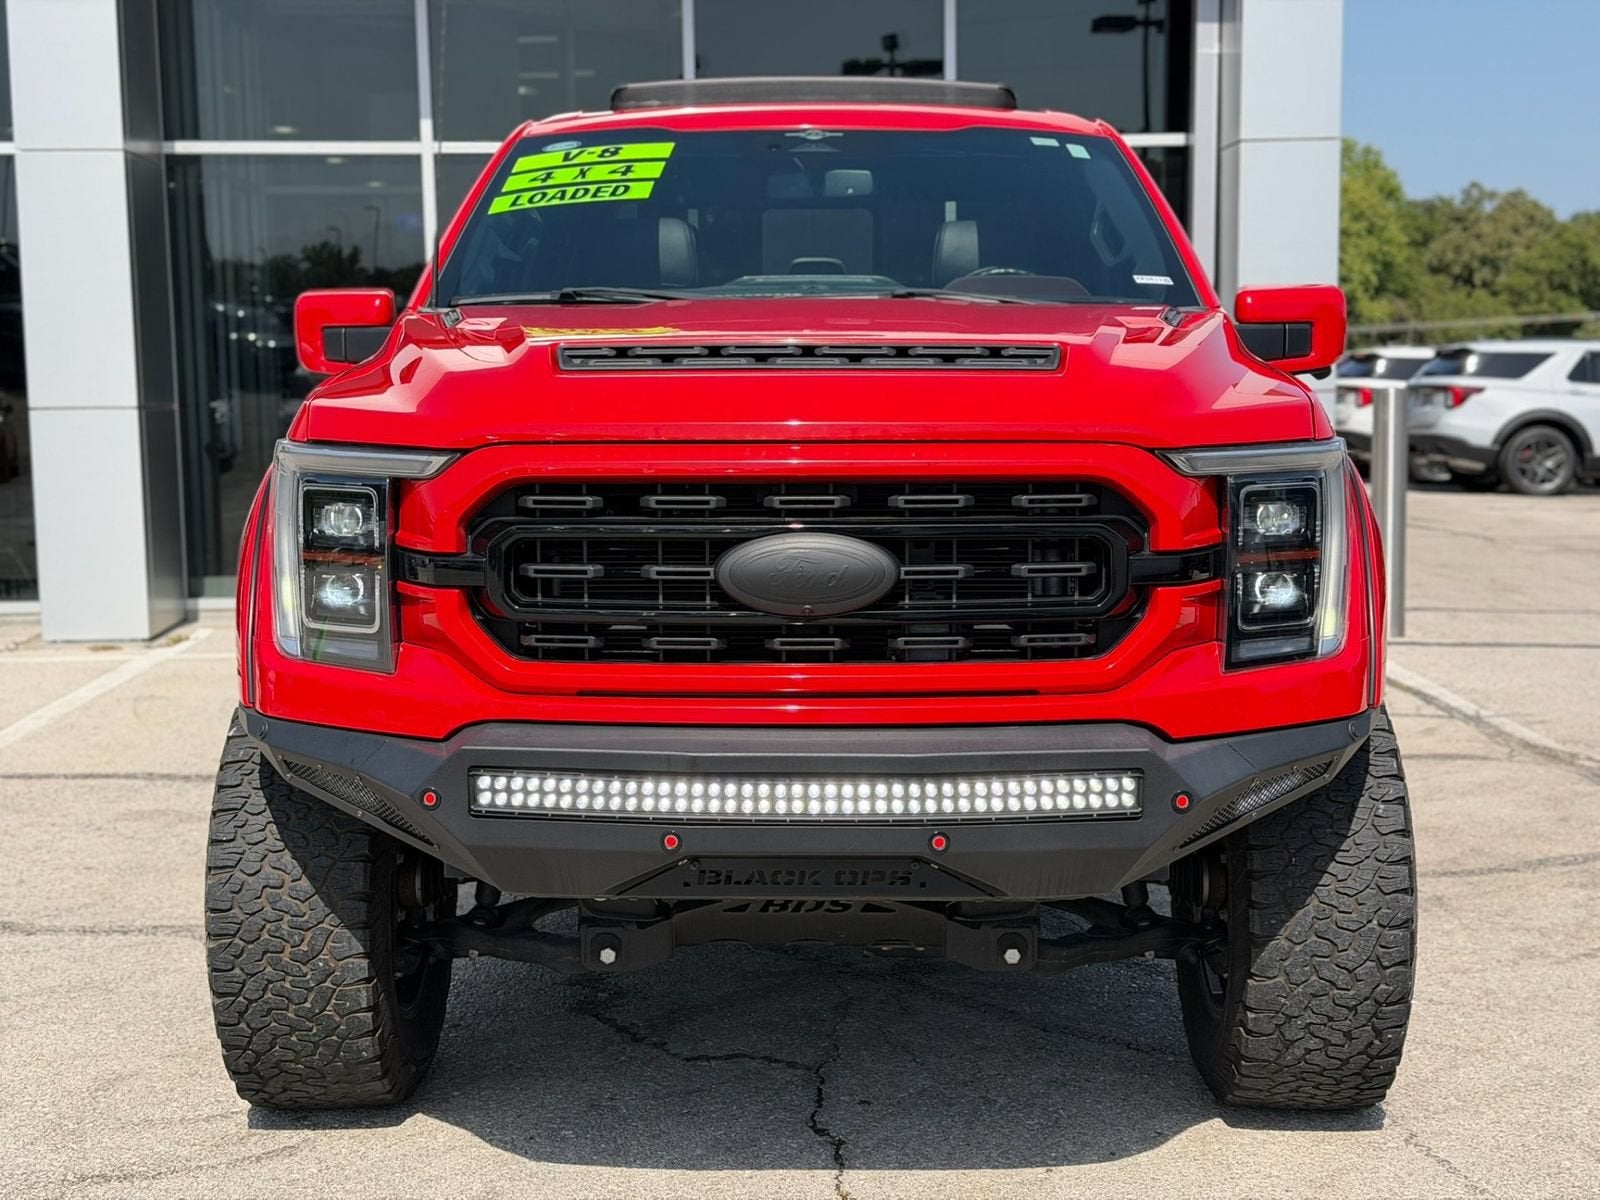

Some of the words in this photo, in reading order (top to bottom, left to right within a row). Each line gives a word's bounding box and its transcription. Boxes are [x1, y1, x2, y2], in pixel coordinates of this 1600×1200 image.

[562, 146, 623, 162] V-8
[528, 171, 555, 183] 4
[608, 164, 635, 177] 4
[508, 184, 631, 208] LOADED
[769, 555, 849, 588] Ford
[696, 869, 822, 886] BLACK
[833, 869, 913, 886] OPS
[758, 900, 853, 913] BDS
